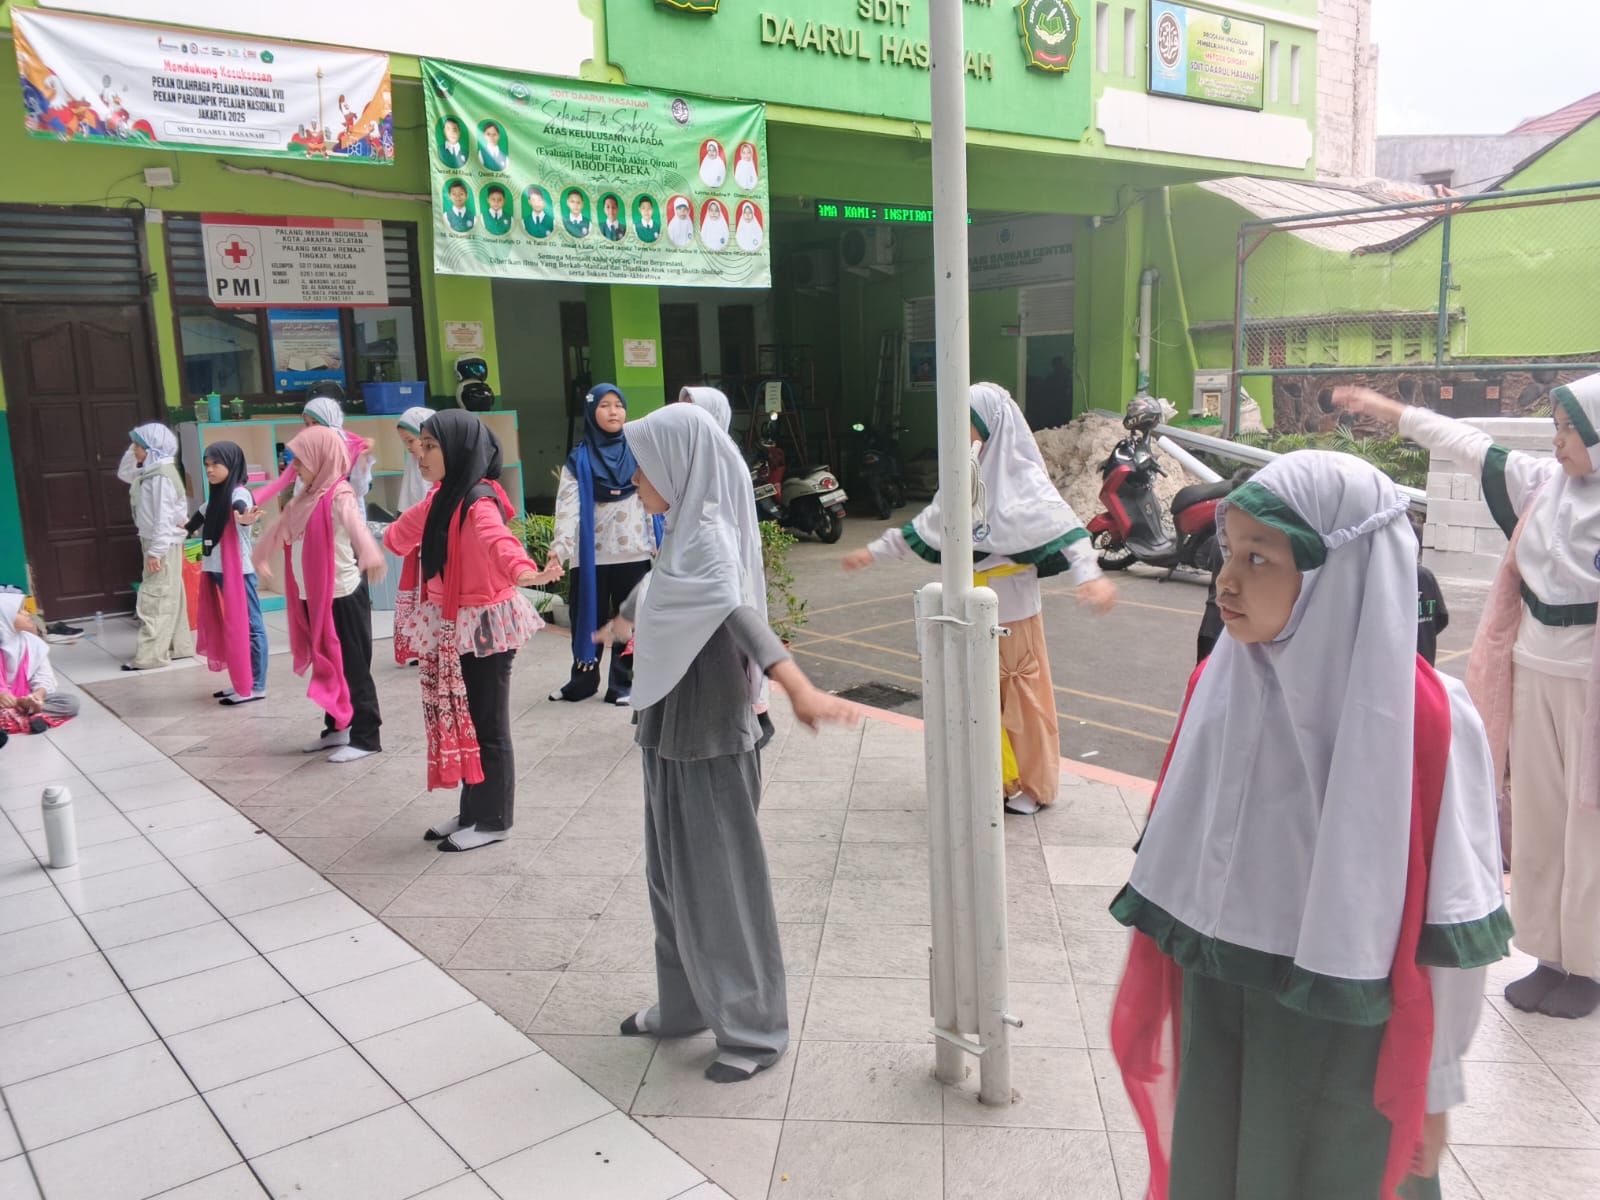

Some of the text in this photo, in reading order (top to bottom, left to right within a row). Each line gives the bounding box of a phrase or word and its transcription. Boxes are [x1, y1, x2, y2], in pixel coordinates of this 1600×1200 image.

[858, 0, 911, 25] SDIT
[760, 12, 996, 81] DAARUL HASAH
[1205, 65, 1230, 77] DAARUL
[1231, 69, 1260, 81] HASANAH
[152, 76, 285, 100] PEKAN OLAHRAGA PELAJAR NASIONAL XVII
[153, 90, 285, 113] PEKAN PARALIMPIK PELAJAR NASIONAL XI
[571, 92, 605, 103] DAARUL
[609, 97, 649, 108] HASANAH
[198, 109, 246, 123] JAKARTA 2025
[543, 126, 664, 147] ATAS KELULUSANNYA PADA
[592, 142, 625, 156] EBTAQ
[605, 153, 627, 165] Tahap
[571, 160, 650, 176] JABODETABEKA
[844, 206, 877, 219] KAMI:
[541, 260, 557, 268] Yang
[216, 278, 261, 297] PMI
